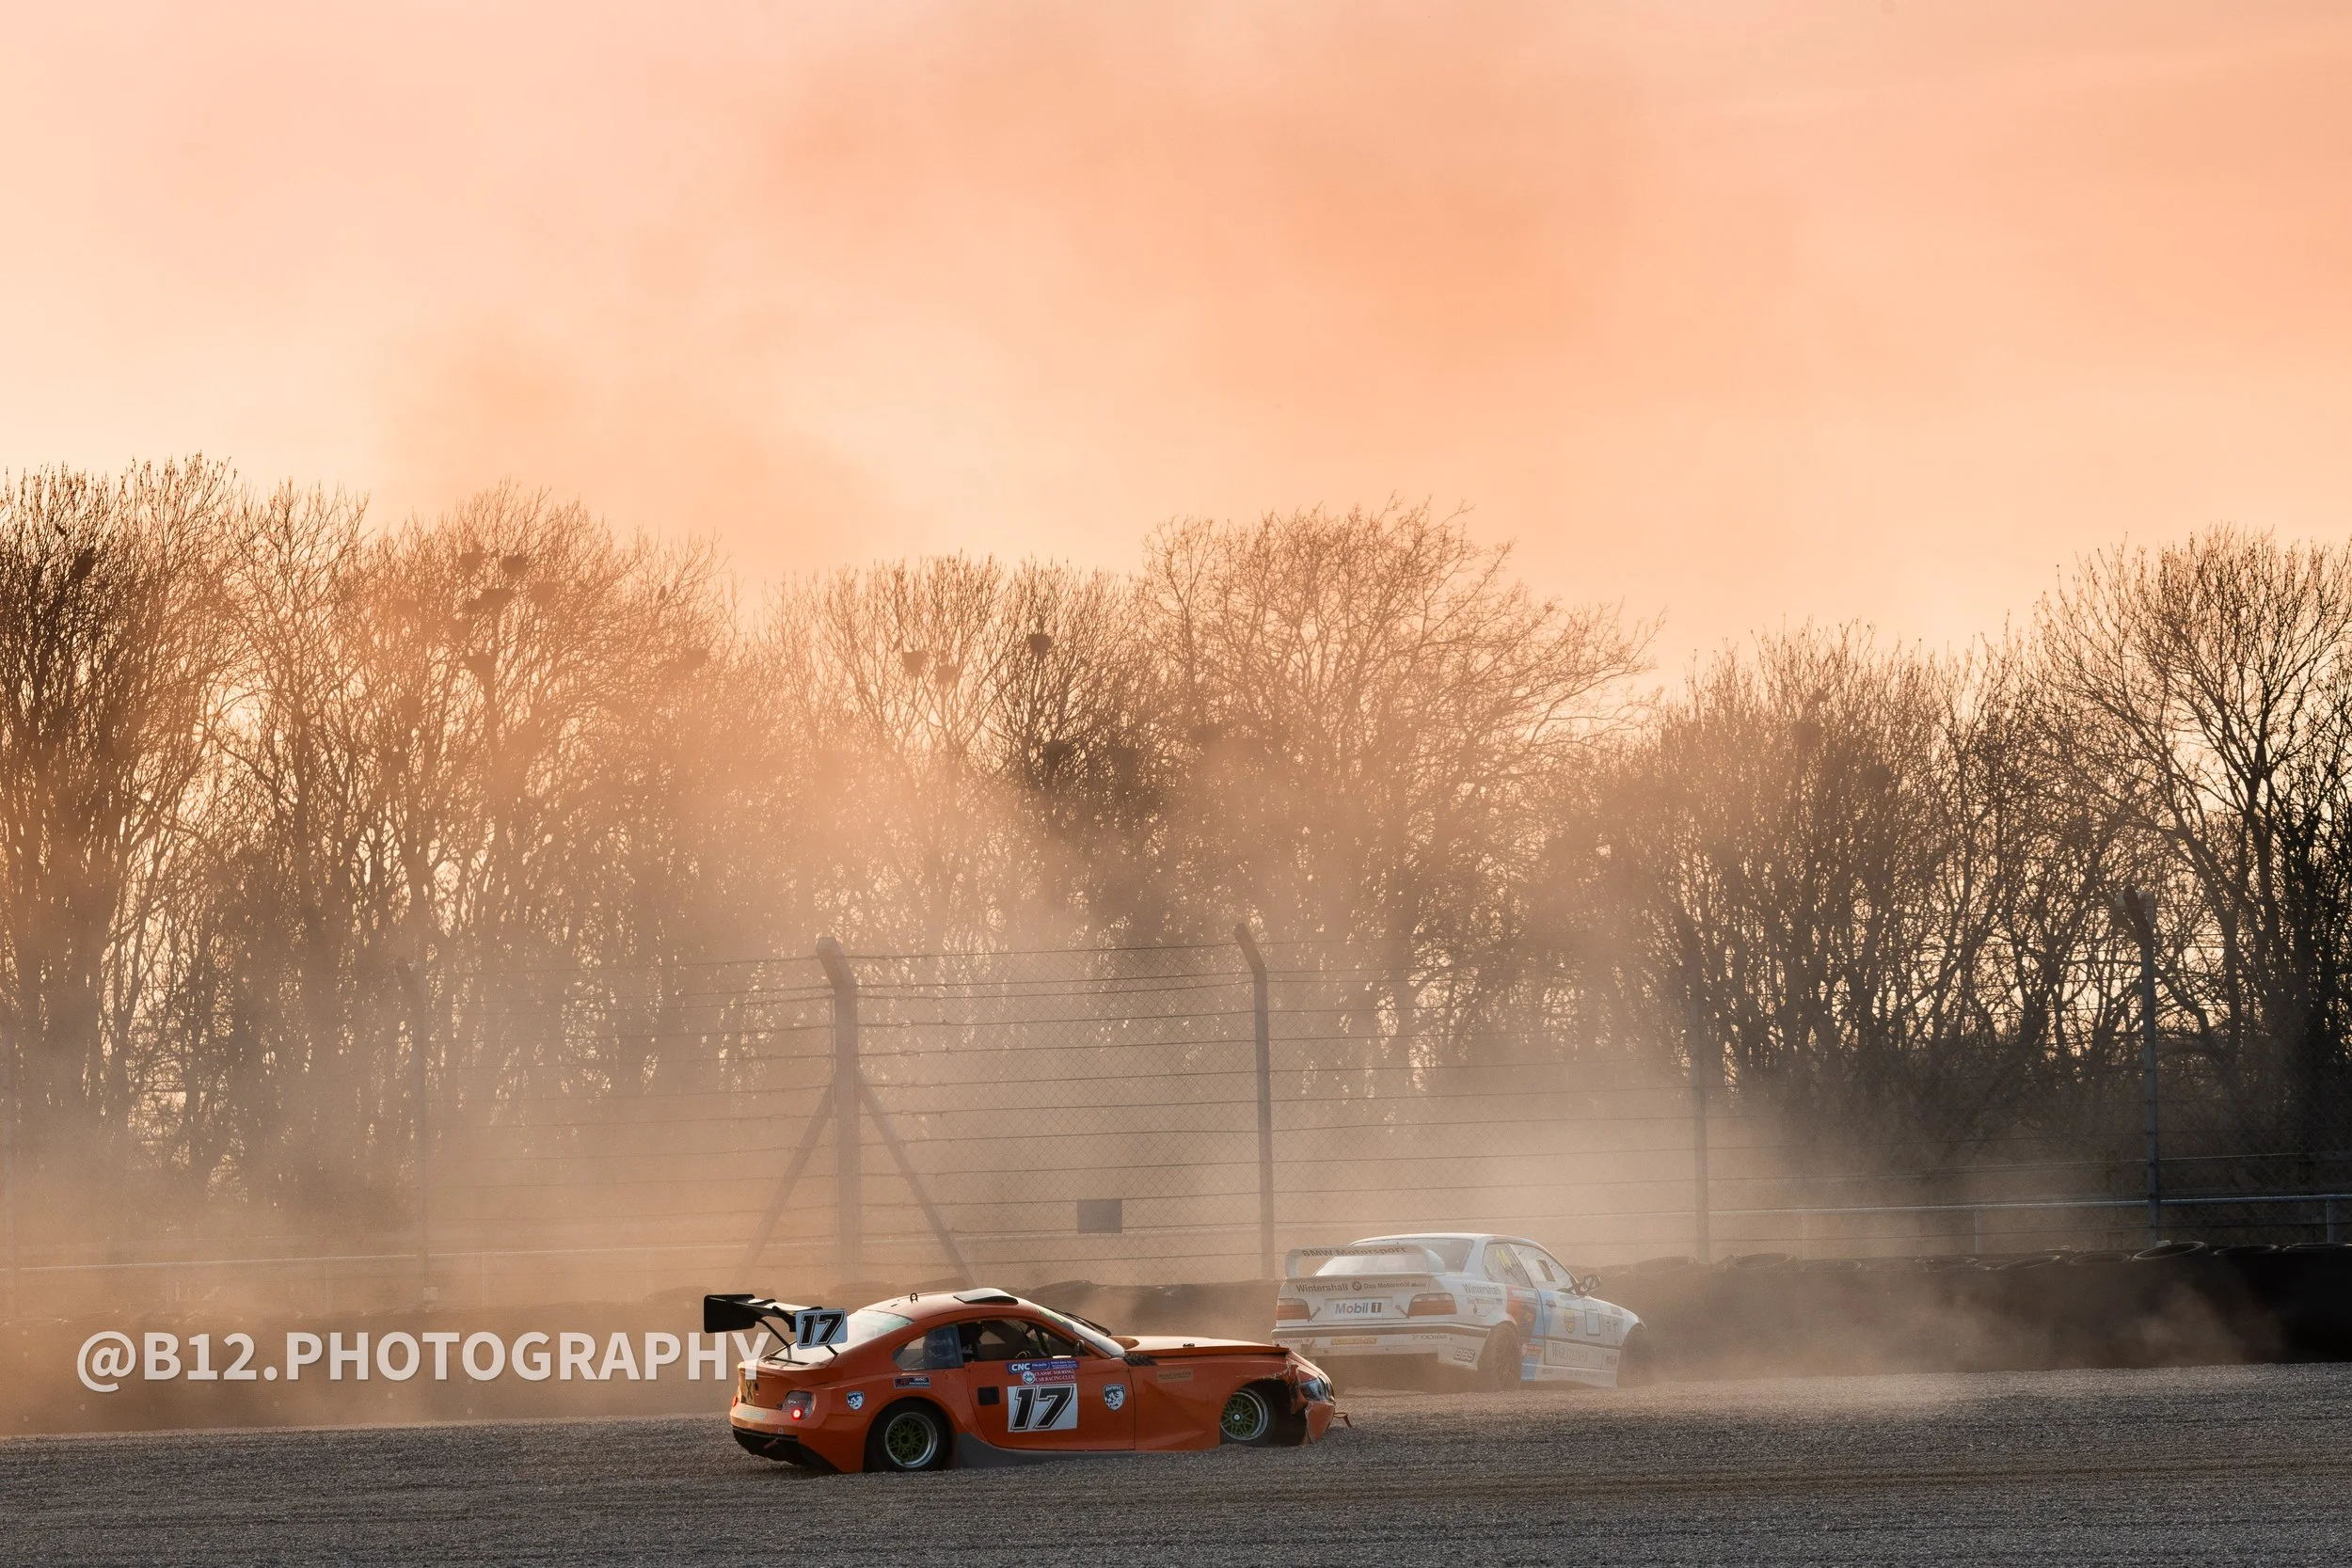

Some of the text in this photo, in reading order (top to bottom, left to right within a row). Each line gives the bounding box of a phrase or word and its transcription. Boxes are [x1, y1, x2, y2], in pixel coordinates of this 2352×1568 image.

[1336, 1246, 1407, 1257] Motorsport
[1295, 1282, 1349, 1293] Wintershall
[1334, 1302, 1369, 1314] Mobil
[800, 1311, 845, 1346] 17
[1011, 1363, 1031, 1371] CNC
[1010, 1385, 1073, 1431] 17
